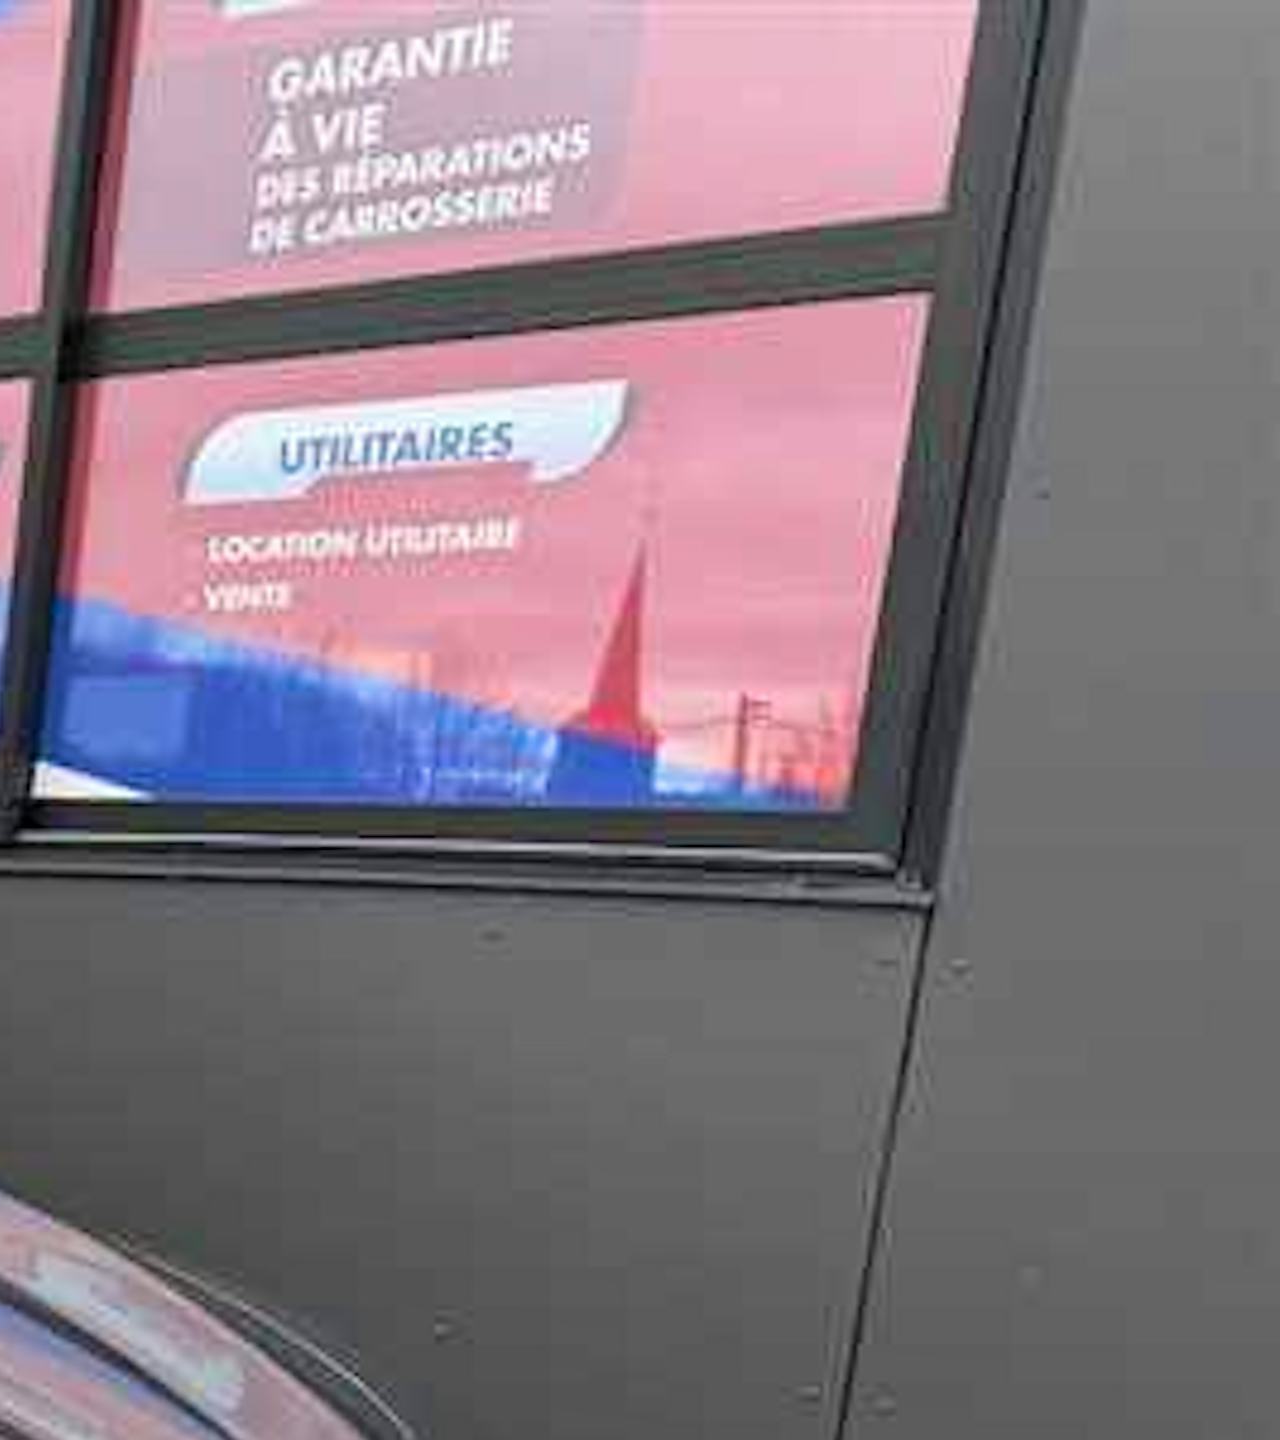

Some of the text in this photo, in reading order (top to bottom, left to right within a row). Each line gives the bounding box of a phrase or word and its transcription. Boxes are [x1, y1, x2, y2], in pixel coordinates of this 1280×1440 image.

[269, 18, 514, 102] GARANTIE
[260, 104, 386, 161] À VIE
[248, 175, 556, 254] DE CARROSSERIE
[255, 164, 323, 211] DES
[278, 421, 515, 475] UTILITAIRES
[206, 514, 516, 564] LOCATION UTILITAIRE
[204, 581, 290, 612] VENTE
